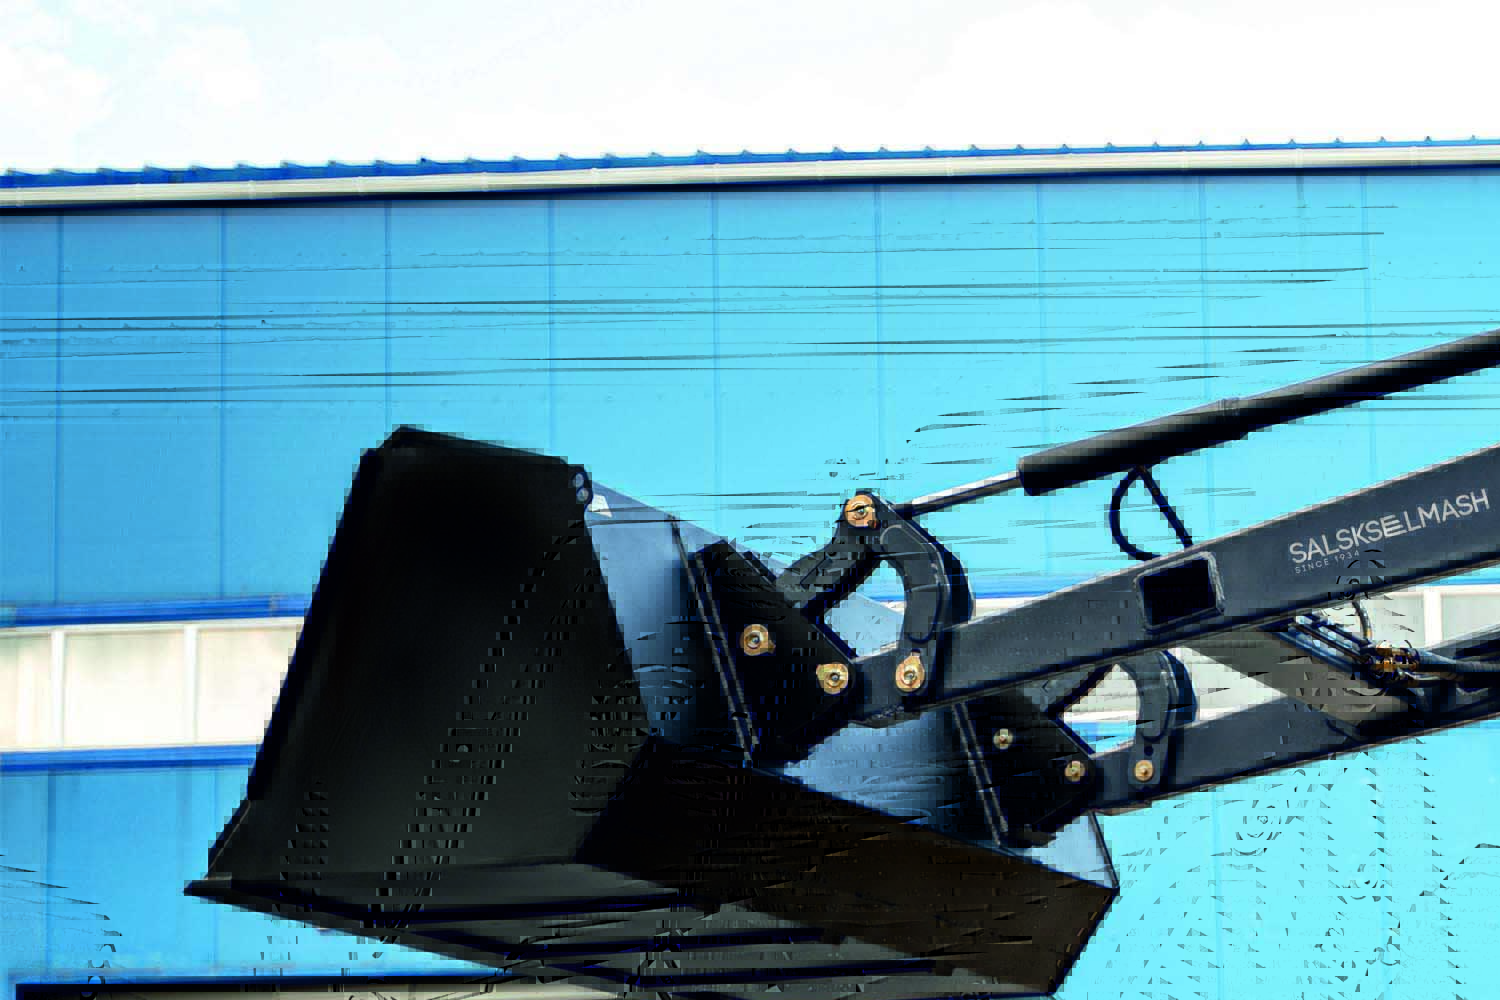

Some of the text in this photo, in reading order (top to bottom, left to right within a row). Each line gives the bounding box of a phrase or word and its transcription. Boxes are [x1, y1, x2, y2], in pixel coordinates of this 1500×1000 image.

[1288, 488, 1491, 564] SALSKSELMASH
[1294, 550, 1360, 574] SINCE 1934
